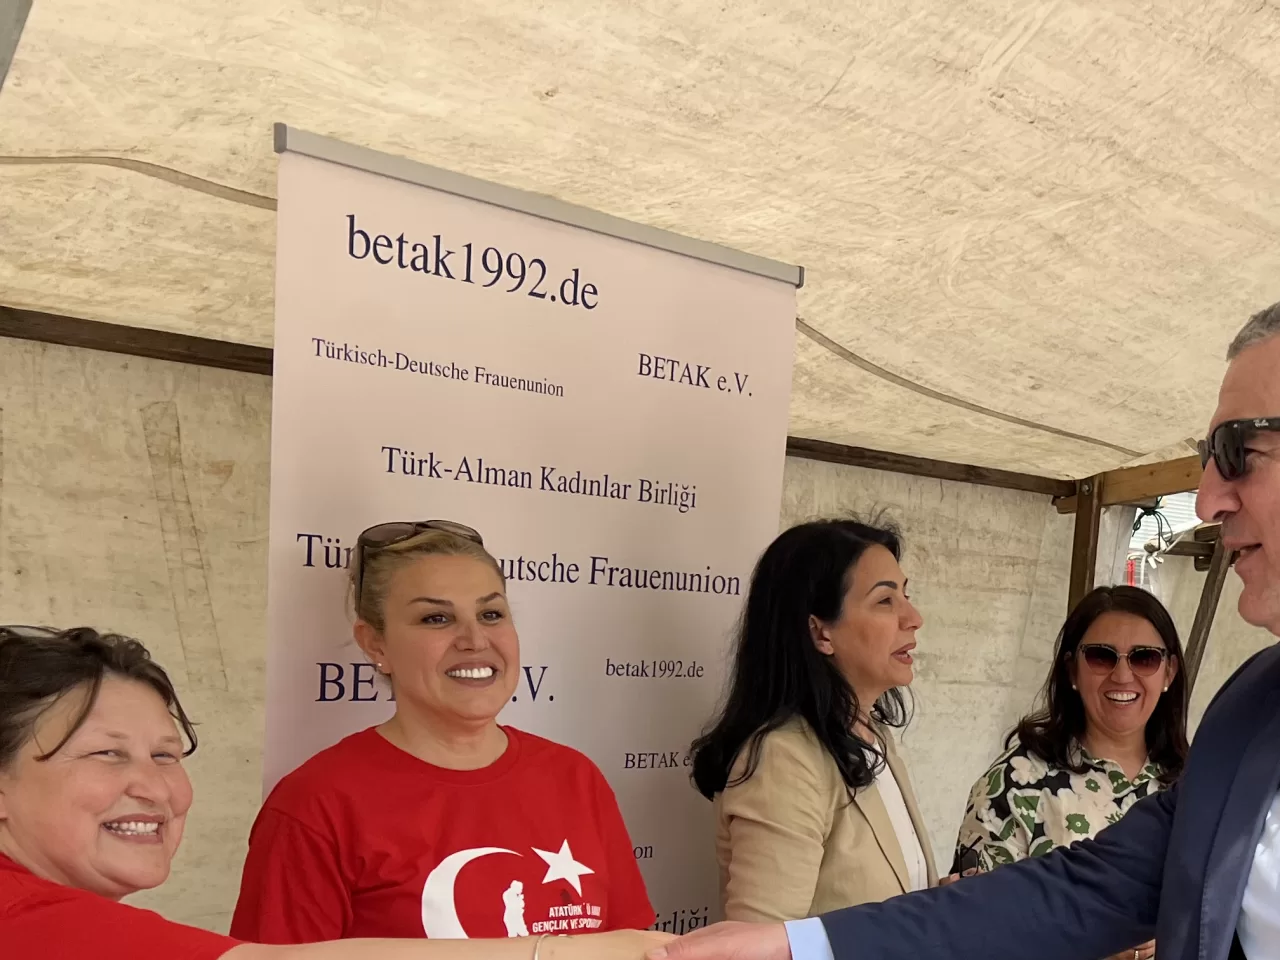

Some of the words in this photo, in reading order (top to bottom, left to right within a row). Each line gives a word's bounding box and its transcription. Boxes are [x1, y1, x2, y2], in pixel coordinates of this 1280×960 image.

[346, 214, 598, 309] betak1992.de
[312, 338, 469, 381] Türkisch-Deutsche
[474, 366, 564, 397] Frauenunion
[638, 353, 711, 389] BETAK
[717, 373, 753, 397] e.V.
[381, 446, 533, 489] Türk-Alman
[539, 466, 631, 501] Kadınlar
[638, 479, 697, 514] Birliği
[588, 556, 741, 595] Frauenunion
[605, 658, 704, 679] betak1992.de
[624, 752, 679, 769] BETAK
